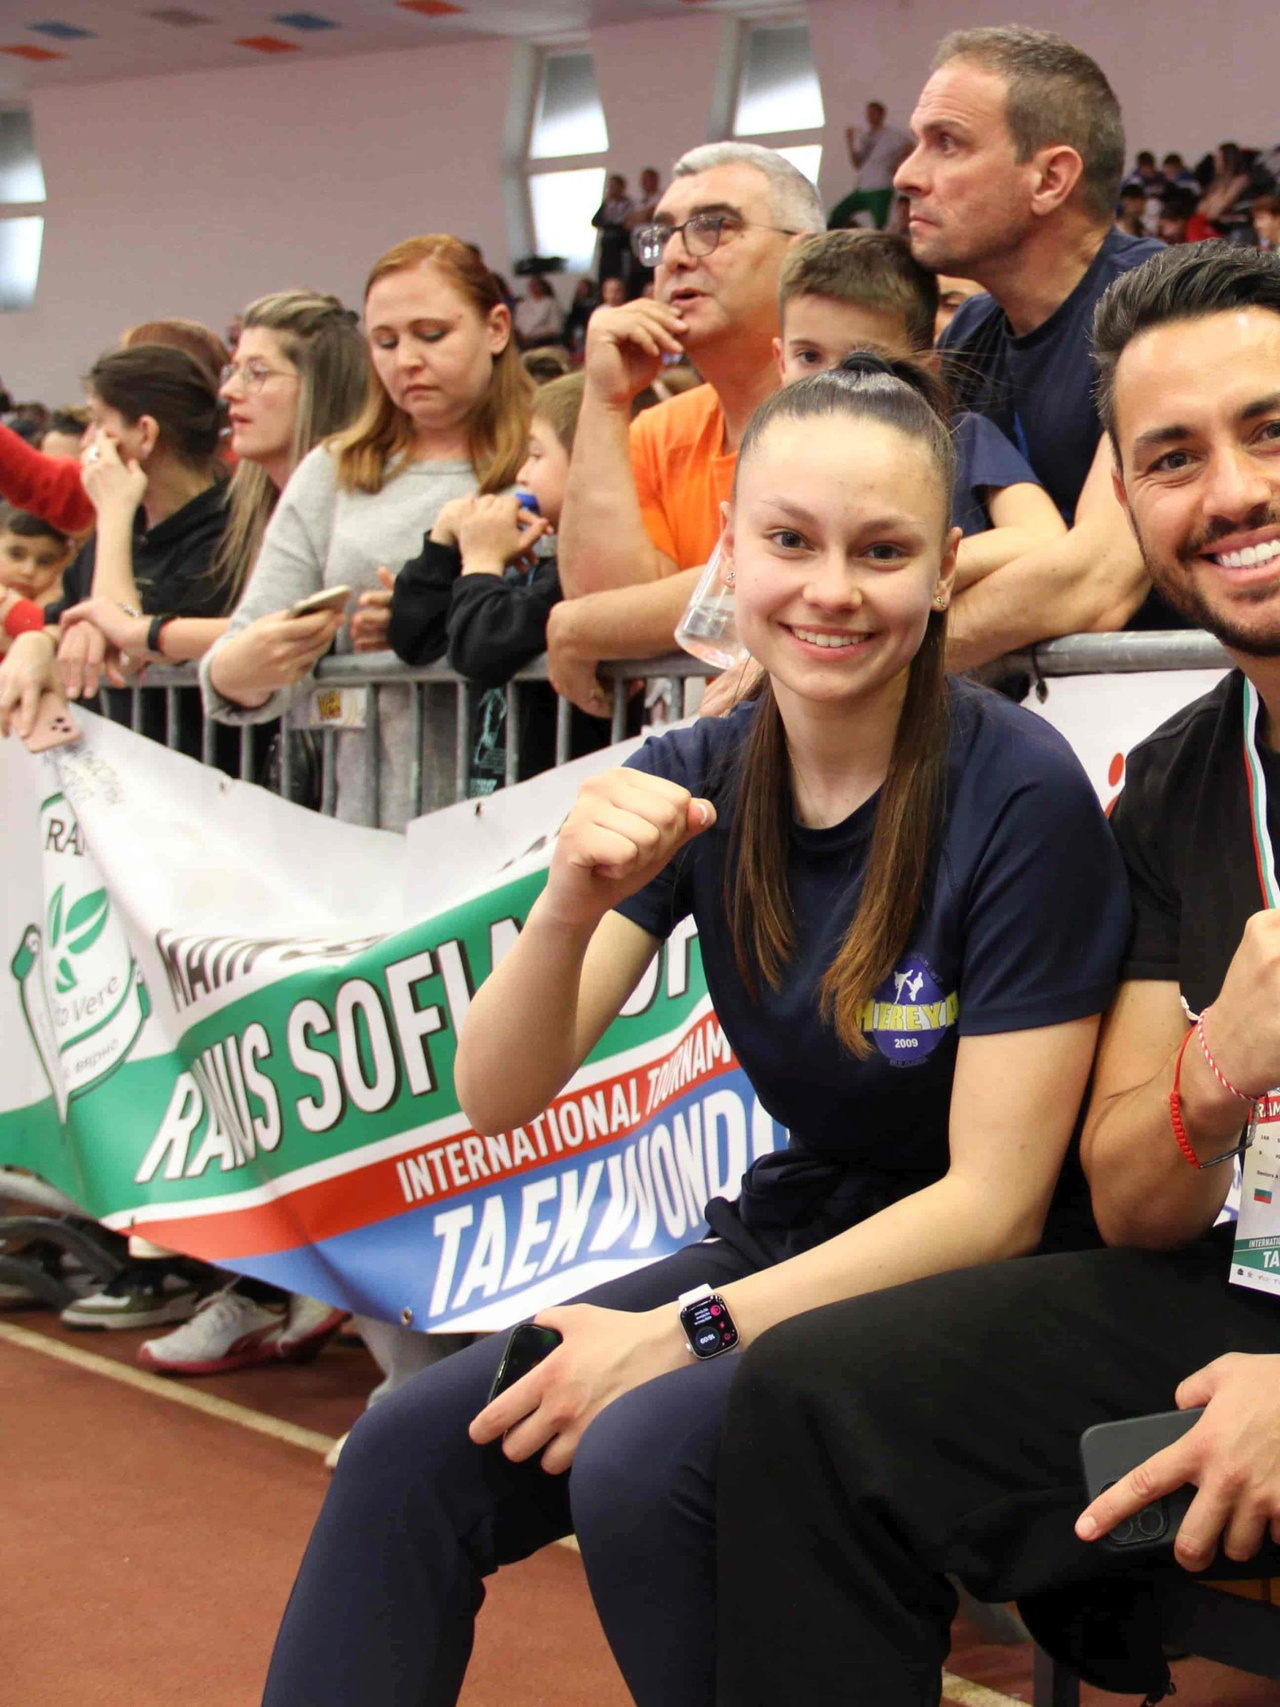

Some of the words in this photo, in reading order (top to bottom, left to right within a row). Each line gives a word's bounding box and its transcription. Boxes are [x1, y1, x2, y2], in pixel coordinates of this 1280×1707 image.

[45, 818, 86, 857] RA
[286, 917, 523, 1134] SOFI
[894, 1037, 918, 1049] 2009
[395, 1077, 641, 1204] INTERNATIONAL
[645, 1018, 732, 1114] TOURNAM
